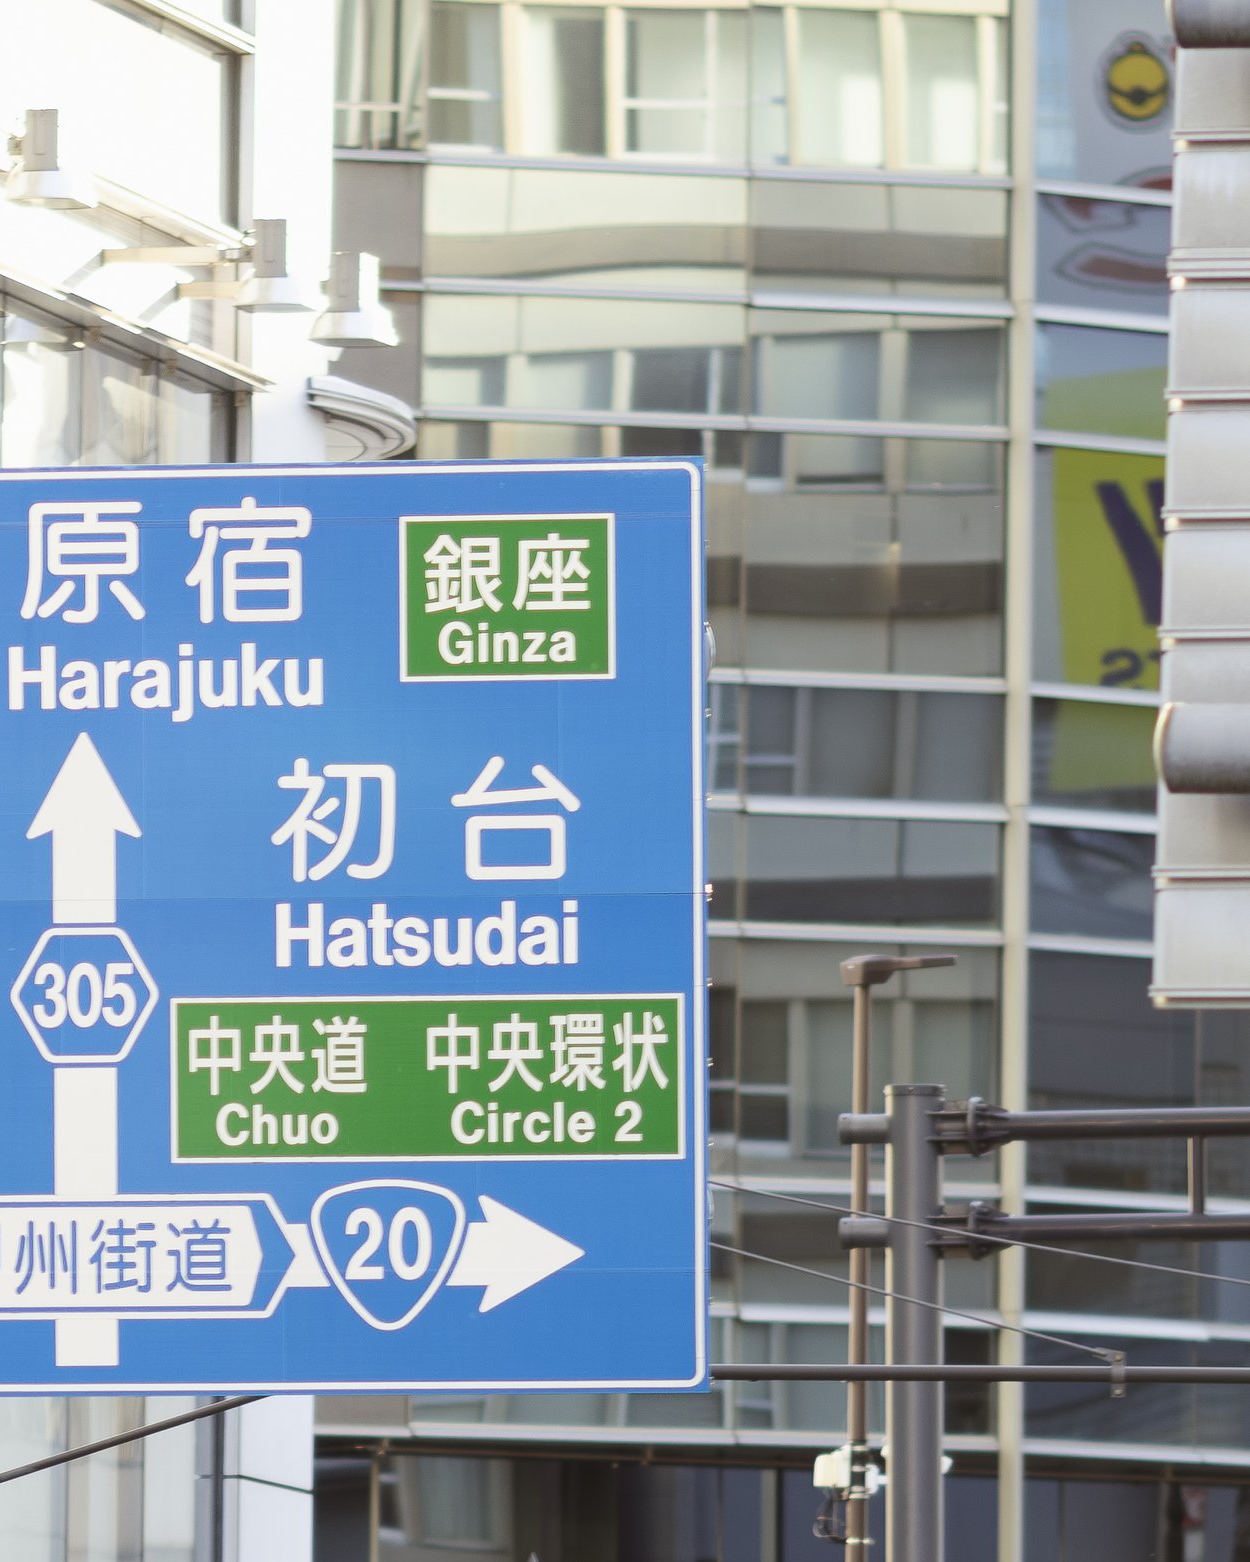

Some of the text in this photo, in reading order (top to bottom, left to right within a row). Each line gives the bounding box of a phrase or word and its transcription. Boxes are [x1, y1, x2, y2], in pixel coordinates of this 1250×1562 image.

[20, 497, 312, 623] 原宿
[423, 532, 591, 613] 銀座
[438, 621, 576, 664] Ginza
[8, 643, 323, 722] Harajuku
[271, 756, 581, 882] 初台
[275, 900, 579, 968] Hatsudai
[32, 962, 137, 1028] 305
[188, 1012, 669, 1095] 中央道 中央環状
[215, 1101, 643, 1146] Chuo Circle 2
[344, 1206, 432, 1281] 20
